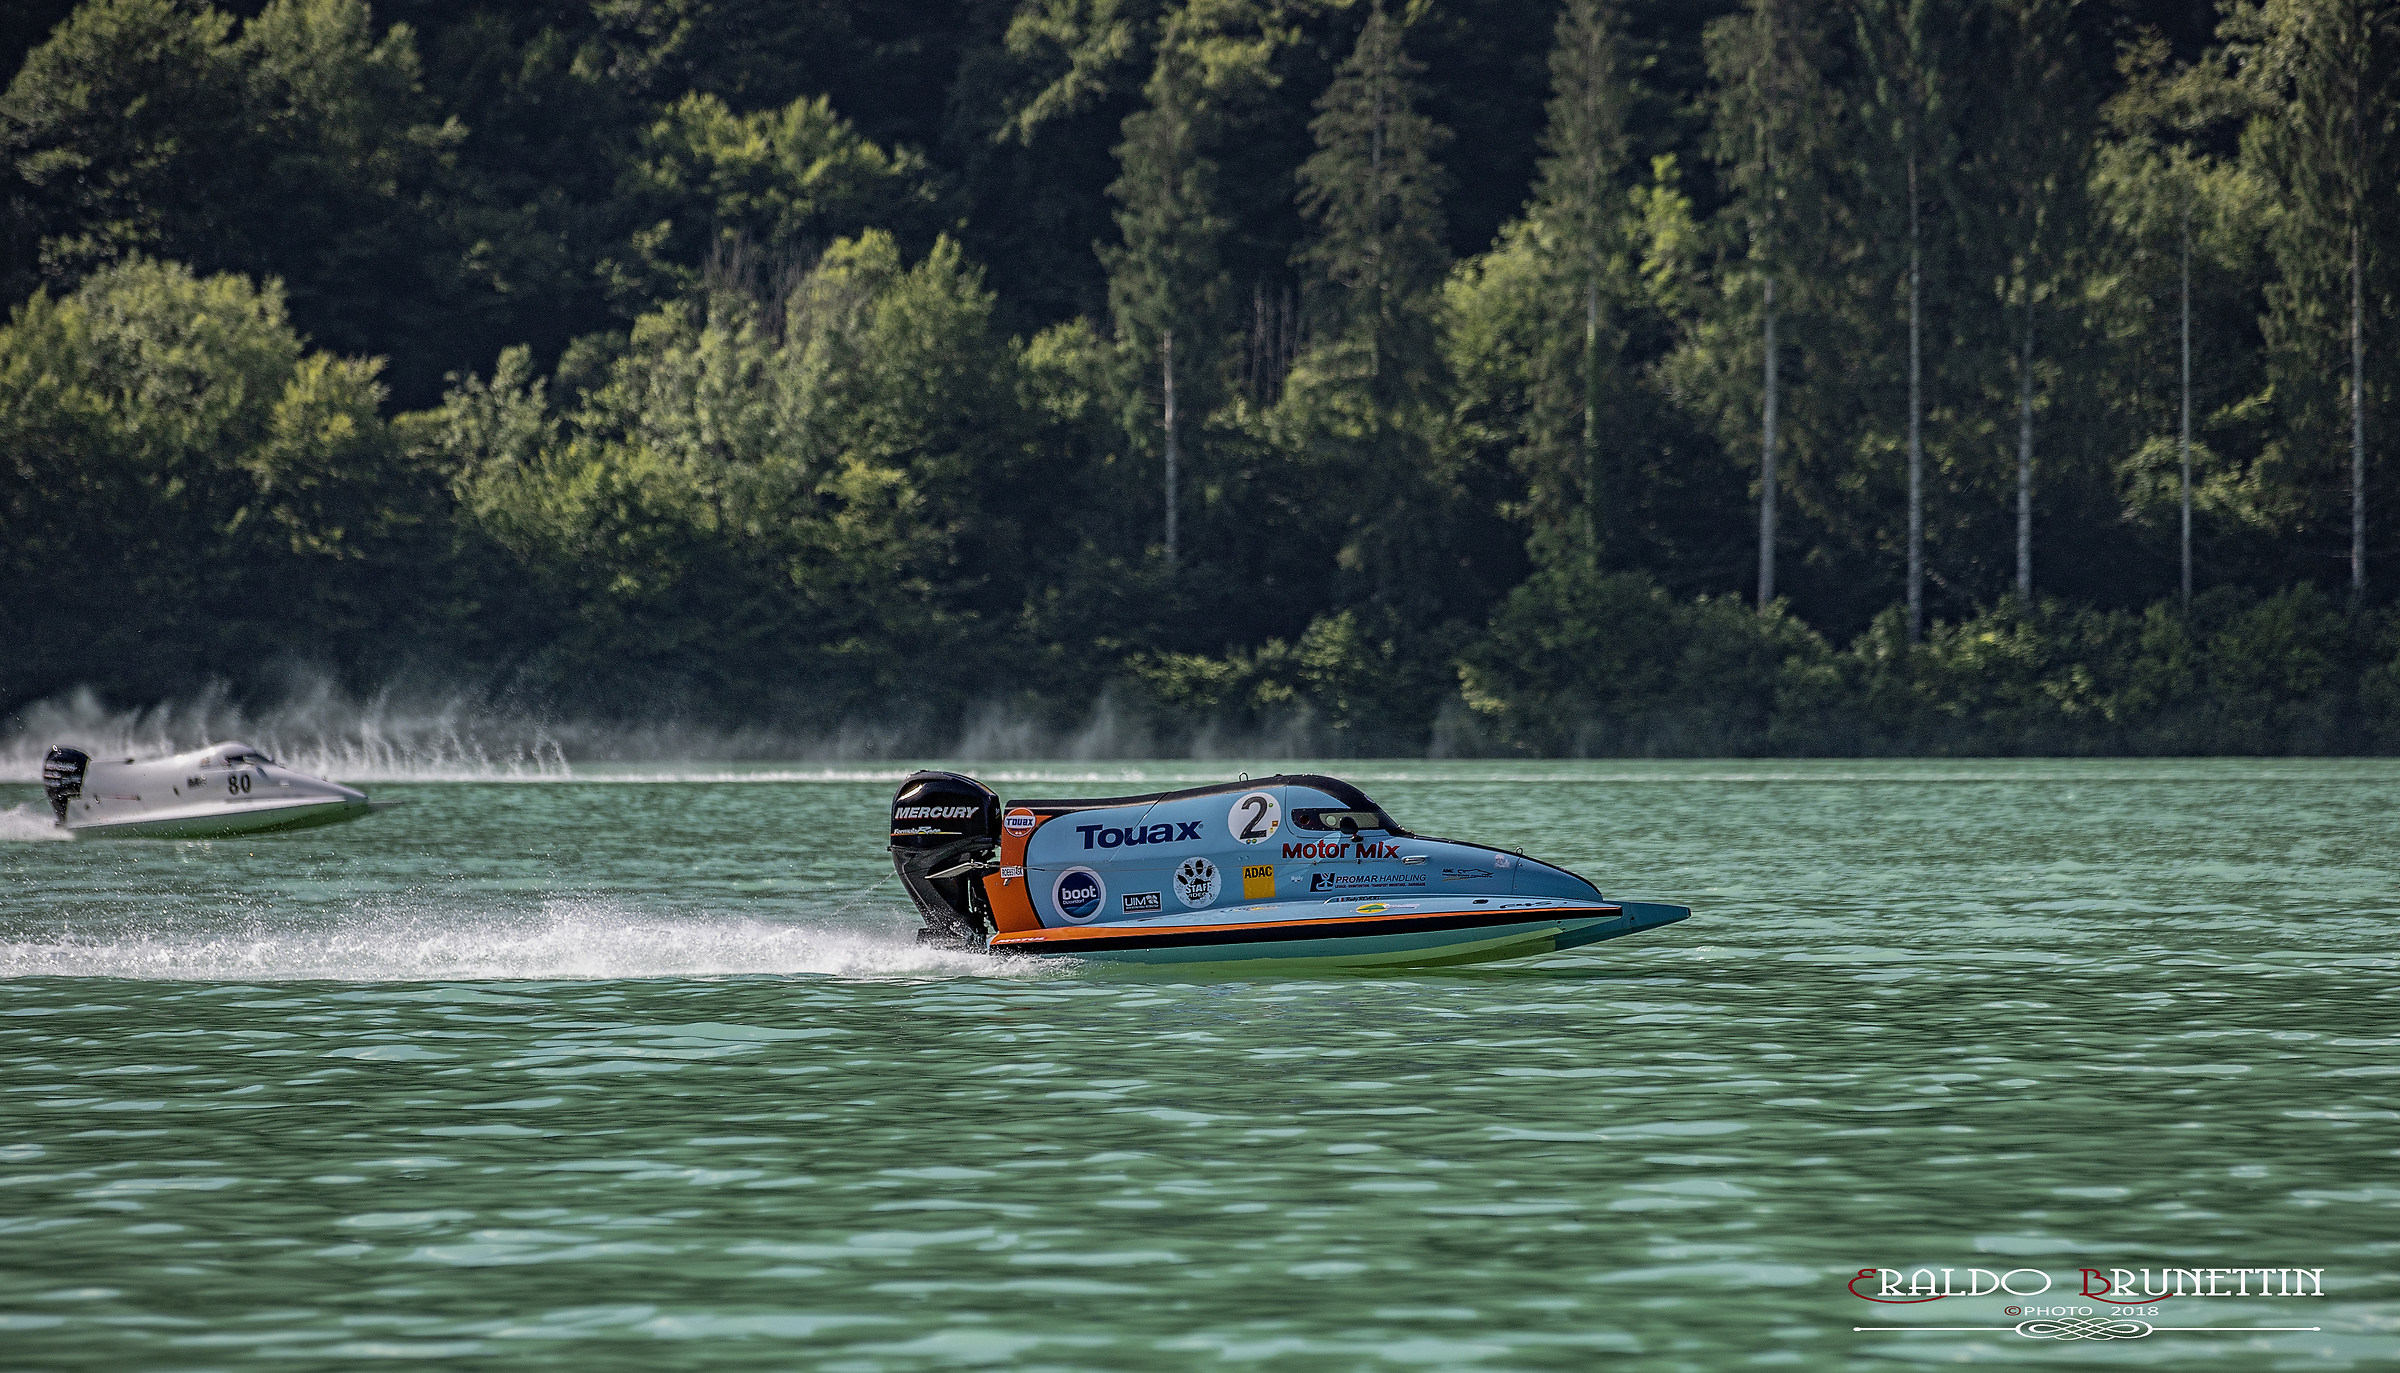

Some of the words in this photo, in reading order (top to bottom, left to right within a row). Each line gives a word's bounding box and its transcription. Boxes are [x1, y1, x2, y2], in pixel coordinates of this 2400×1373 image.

[228, 774, 251, 795] 80
[895, 806, 979, 820] MERCURY
[1239, 796, 1267, 840] 2
[1282, 840, 1350, 858] Motor
[1355, 841, 1400, 858] Mix
[1244, 866, 1273, 878] ADAC
[1335, 874, 1379, 884] PROMAR
[1379, 873, 1427, 882] HANDLING
[1062, 885, 1097, 900] boot
[1185, 881, 1212, 894] STAFF
[1125, 896, 1147, 906] UIM
